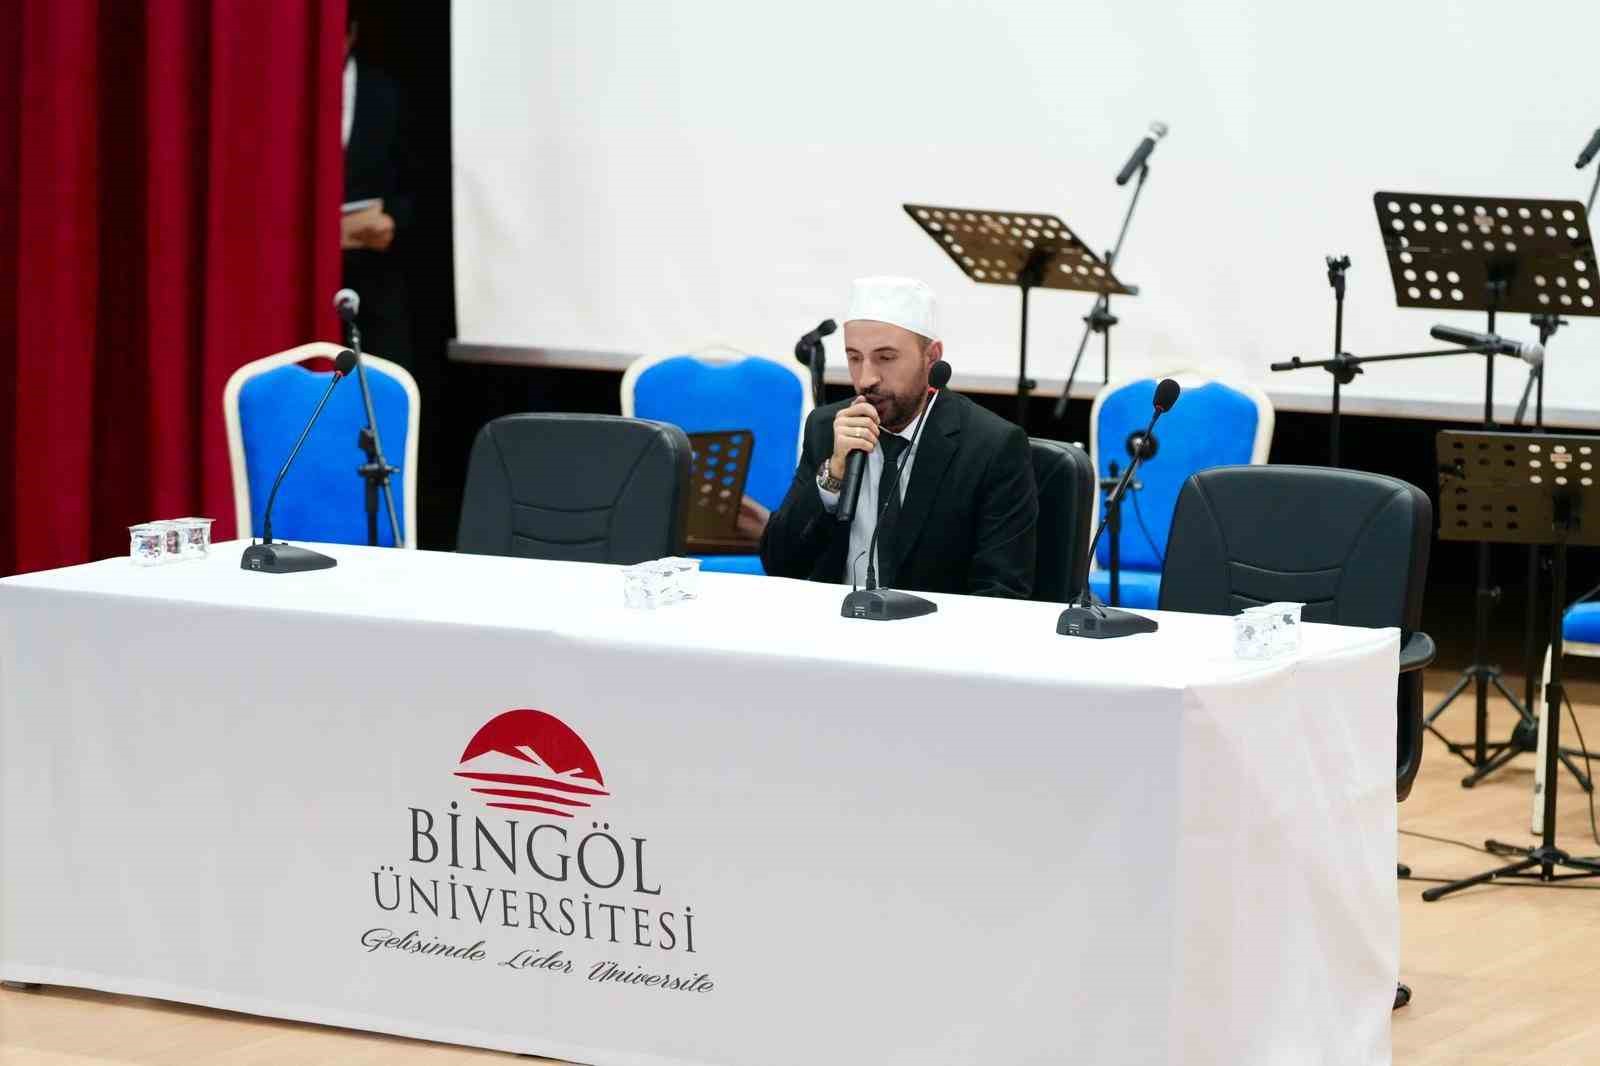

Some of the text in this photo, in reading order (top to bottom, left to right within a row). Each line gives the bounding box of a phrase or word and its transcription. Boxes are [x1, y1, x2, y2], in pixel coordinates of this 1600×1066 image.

[408, 801, 661, 895] BİNGÖL
[372, 865, 696, 953] ÜNİVERSİTESİ
[498, 949, 574, 974] Lider
[587, 961, 714, 993] Üniversite
